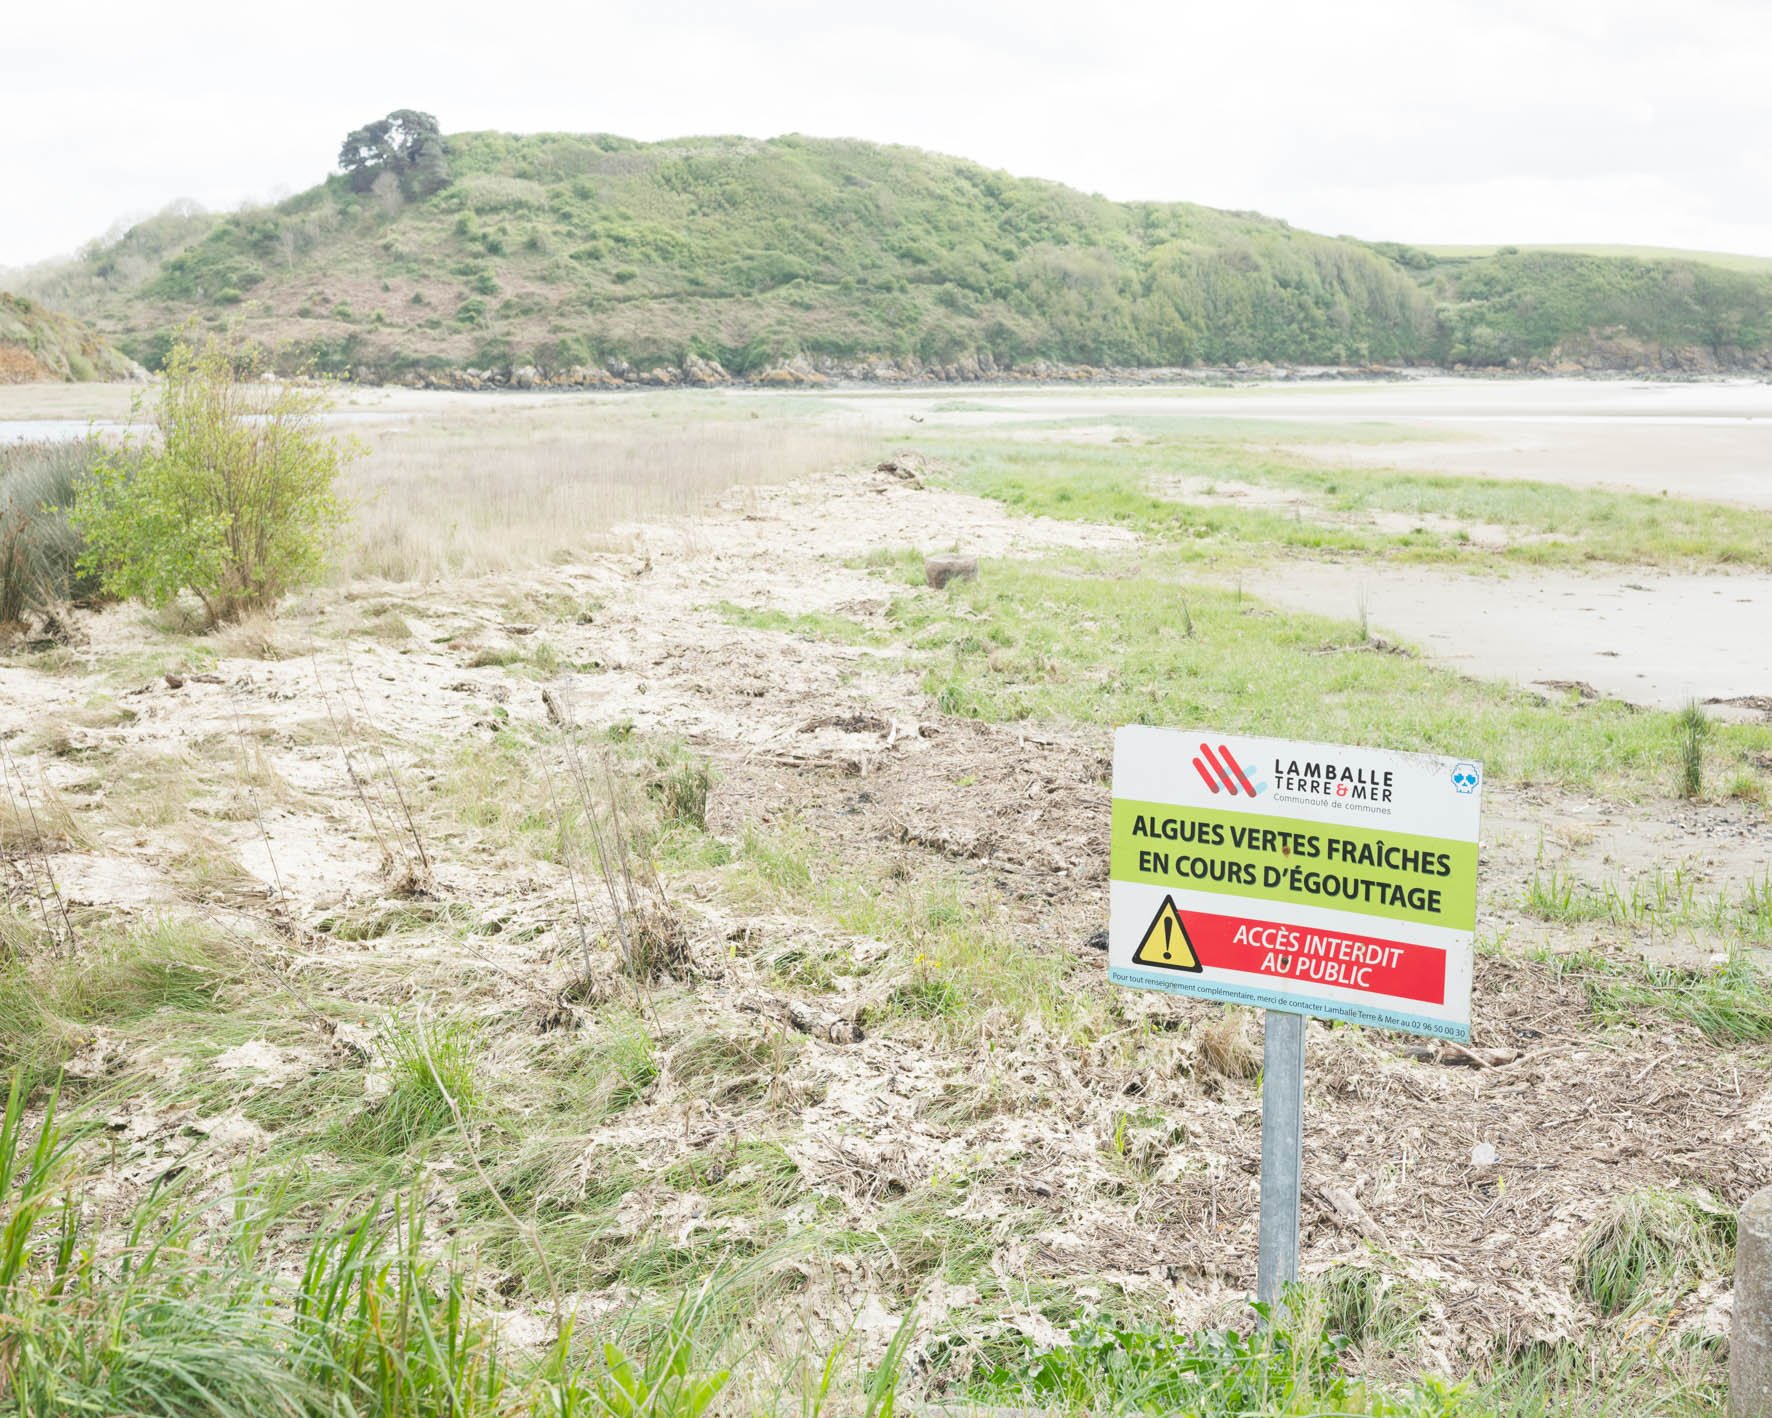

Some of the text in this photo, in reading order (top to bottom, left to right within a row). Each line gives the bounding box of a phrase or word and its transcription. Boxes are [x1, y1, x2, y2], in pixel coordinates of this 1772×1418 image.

[1275, 759, 1393, 787] LAMBALLE
[1273, 793, 1392, 815] Communauté de communes
[1132, 815, 1451, 877] ALGUES VERTES FRAÎCHES
[1139, 850, 1169, 875] EN
[1175, 855, 1257, 886] COURS
[1232, 925, 1404, 969] ACCÈS INTERDIT
[1260, 952, 1373, 988] AU PUBLIC
[1112, 972, 1128, 981] Pour
[1129, 974, 1144, 983] tout
[1144, 978, 1196, 991] renseignement
[1257, 995, 1278, 1004] merci
[1278, 998, 1288, 1006] de
[1288, 1000, 1323, 1012] contacter
[1324, 1004, 1357, 1018] Lamballe
[1358, 1010, 1377, 1021] Terre
[1377, 1014, 1384, 1022] &
[1384, 1015, 1400, 1025] Mer
[1400, 1020, 1410, 1028] au
[1411, 1020, 1421, 1029] 02
[1422, 1022, 1432, 1032] 96
[1433, 1024, 1443, 1033] 50
[1444, 1026, 1455, 1036] 00
[1455, 1028, 1466, 1038] 30
